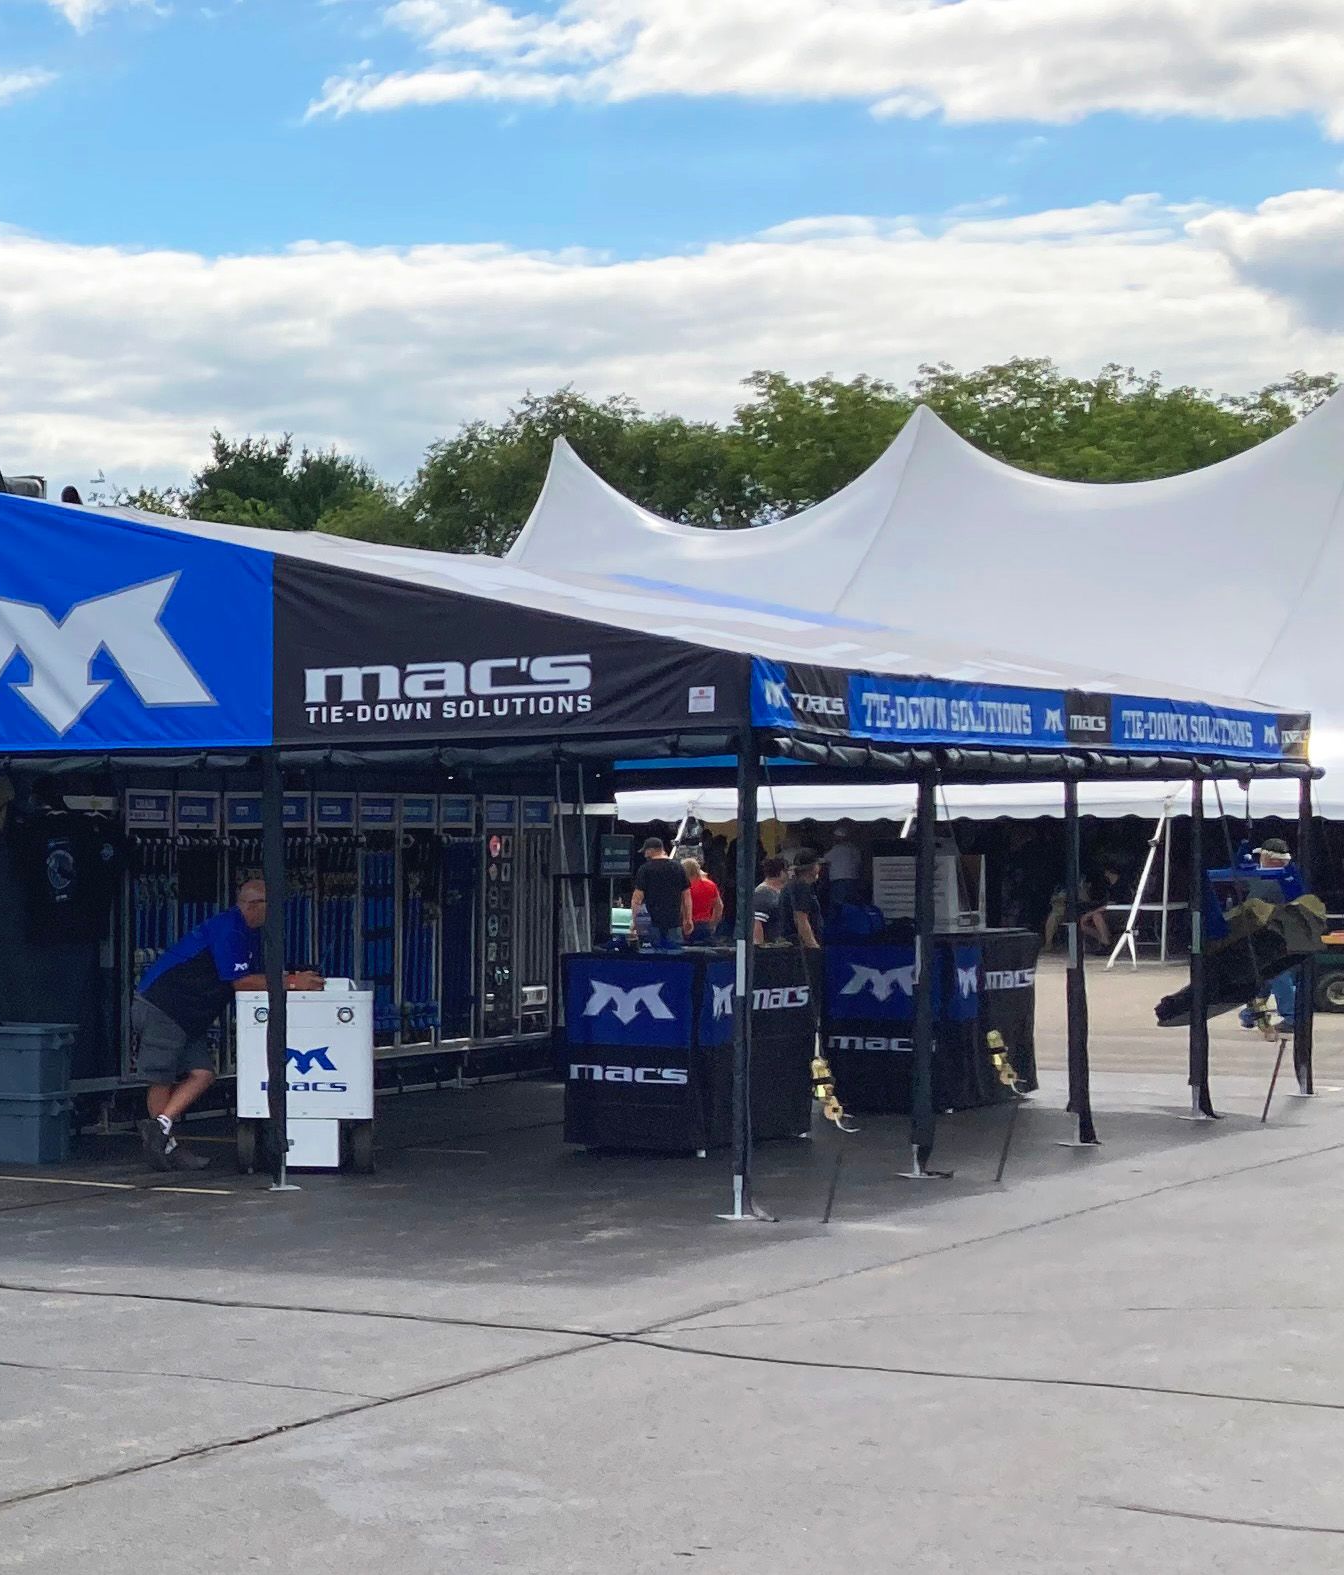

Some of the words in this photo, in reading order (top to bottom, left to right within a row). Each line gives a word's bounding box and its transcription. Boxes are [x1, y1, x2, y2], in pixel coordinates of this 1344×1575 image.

[304, 653, 593, 704] mac's
[305, 702, 432, 724] TIE-DOWN
[442, 694, 593, 719] SOLUTIONS
[1121, 710, 1188, 742] TIE-DOWN
[1189, 716, 1254, 748] SOLUTIONS
